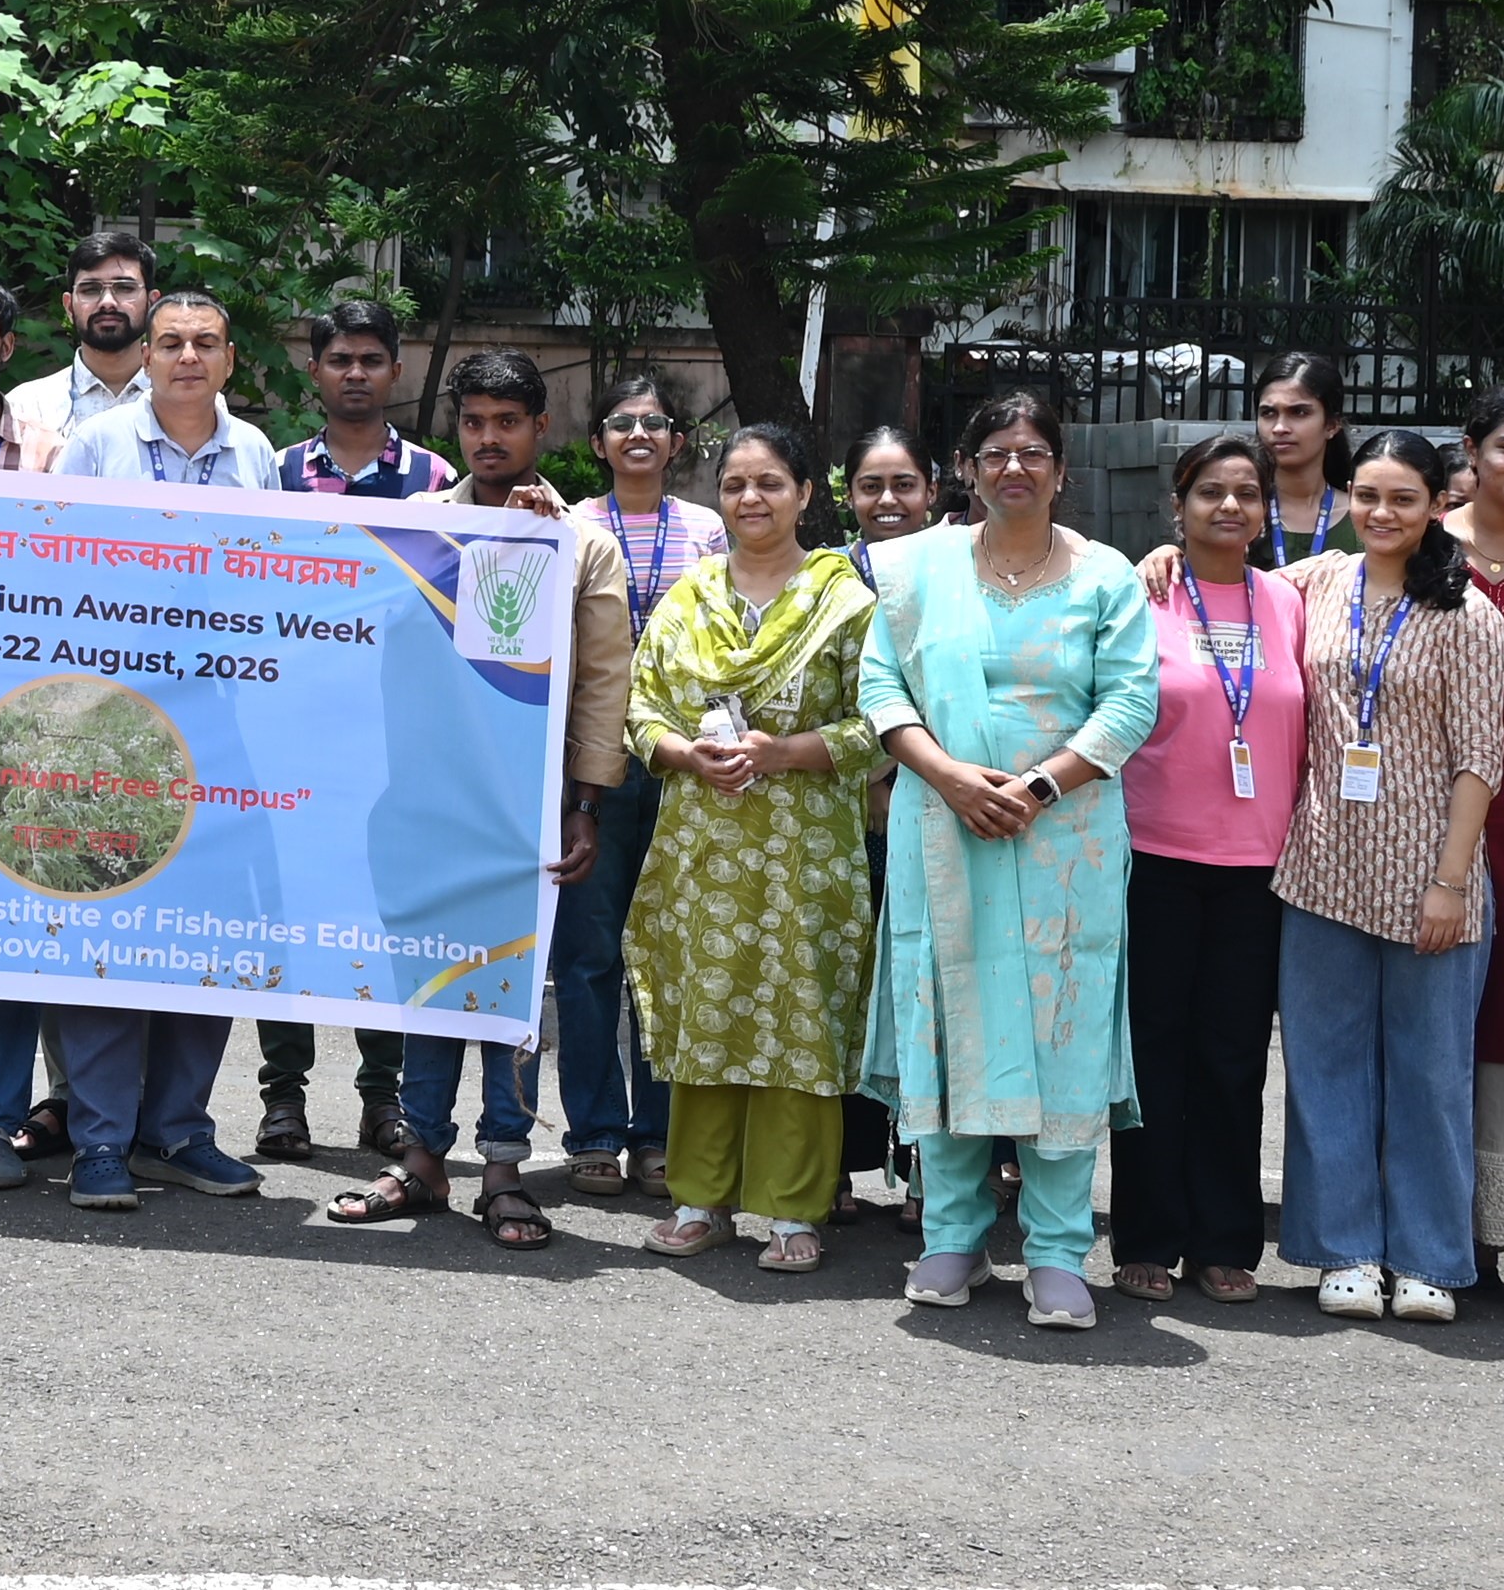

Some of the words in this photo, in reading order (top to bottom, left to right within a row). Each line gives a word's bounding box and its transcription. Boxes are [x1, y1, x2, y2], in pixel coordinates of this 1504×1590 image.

[72, 594, 264, 635] Awareness
[275, 611, 377, 646] Week
[49, 639, 185, 681] August,
[194, 652, 280, 683] 2026
[489, 644, 523, 656] ICAR
[167, 776, 313, 812] Campus”
[12, 824, 79, 851] गाजर
[87, 830, 140, 855] घास
[110, 904, 147, 932] of
[155, 906, 306, 945] Fisheries
[316, 922, 489, 966] Education
[81, 937, 266, 978] Mumbai-61
